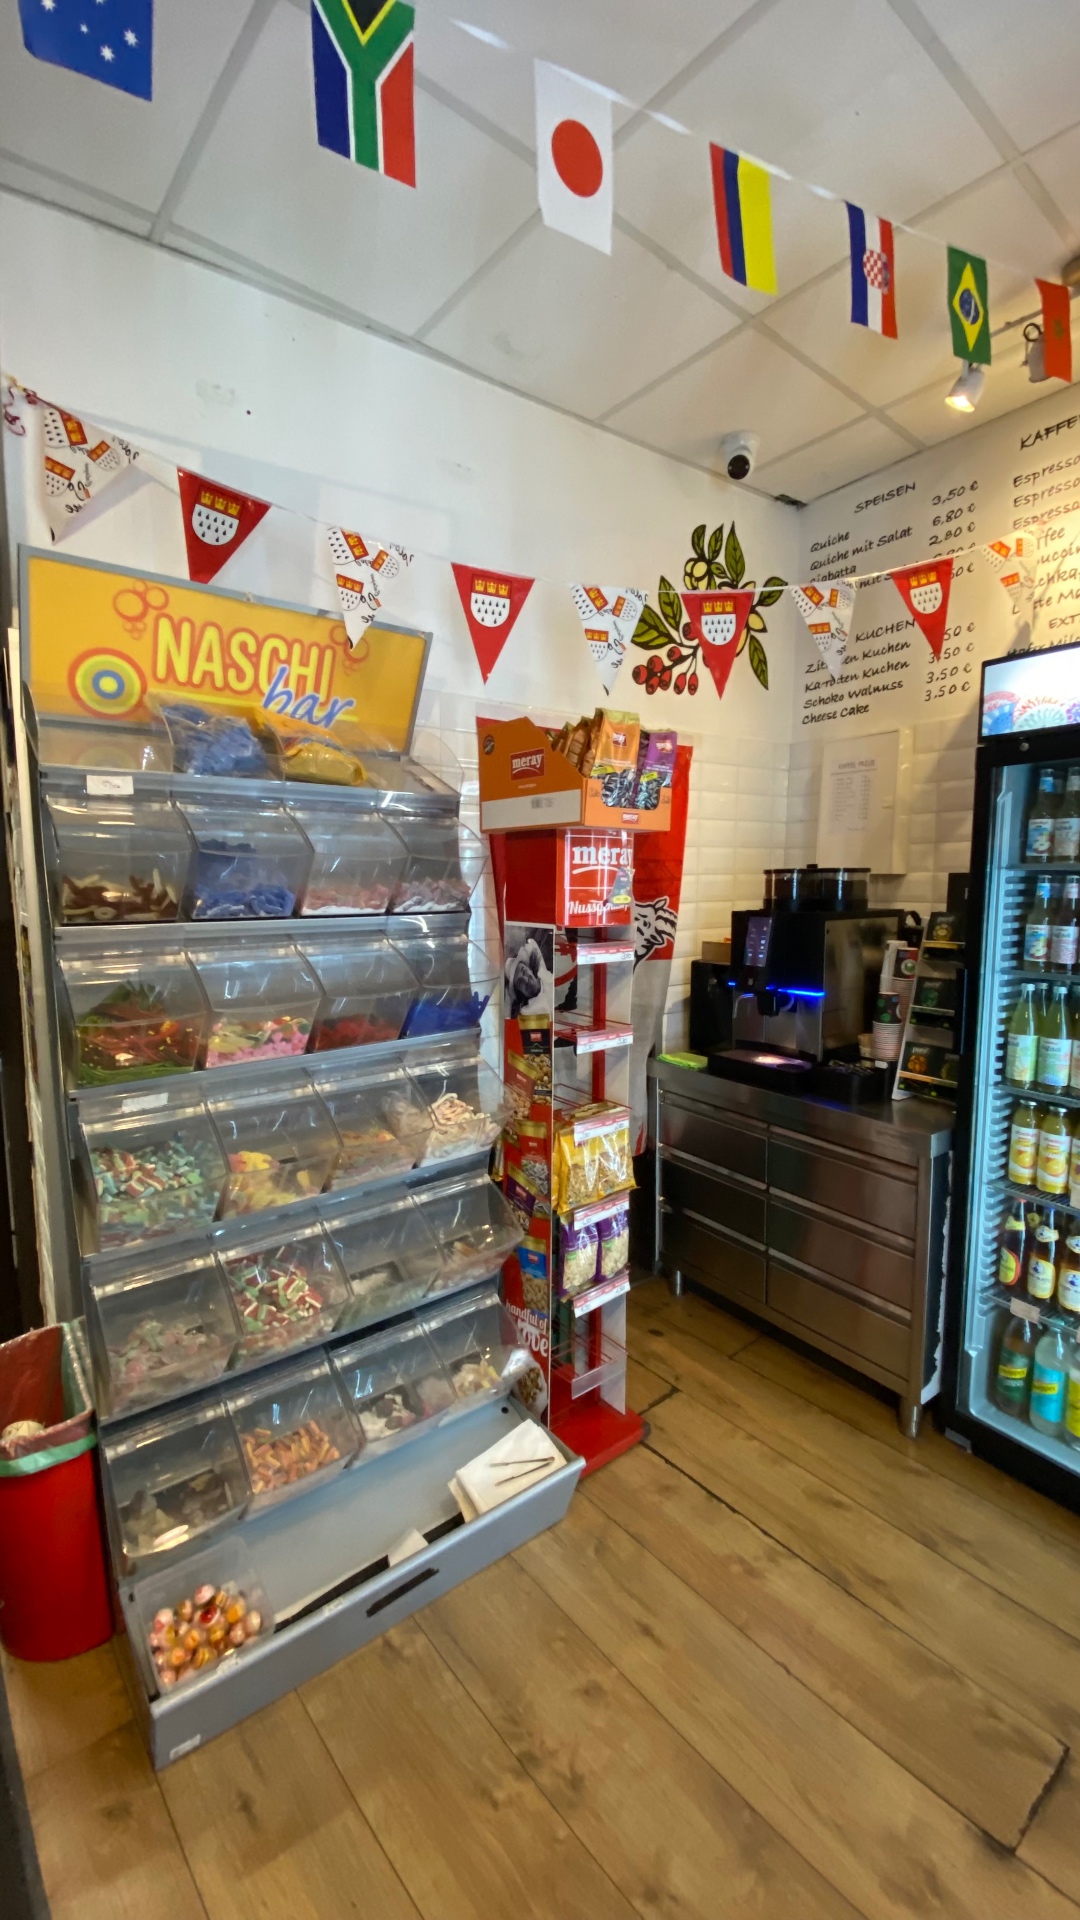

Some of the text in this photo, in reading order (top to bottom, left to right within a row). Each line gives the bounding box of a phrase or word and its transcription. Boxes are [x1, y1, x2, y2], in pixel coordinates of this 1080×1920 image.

[1019, 414, 1080, 451] KAFFE
[1013, 454, 1080, 488] Espresso
[854, 481, 916, 513] SPEISEN
[1013, 477, 1080, 508] Espresso
[810, 480, 979, 553] Quiche 3,50 €
[967, 521, 976, 533] €
[809, 550, 849, 571] Quiche
[852, 539, 874, 556] mit
[876, 526, 912, 547] Salat
[967, 503, 976, 513] €
[966, 562, 975, 573] €
[855, 618, 916, 643] KUCHEN
[862, 641, 911, 660] Kuchen
[966, 621, 976, 633] €
[154, 613, 335, 704] NASCHI
[862, 661, 910, 679] Kuchen
[966, 642, 975, 652] €
[262, 665, 355, 729] bar
[802, 709, 838, 725] Cheese
[839, 704, 870, 718] Cake
[961, 681, 971, 692] €
[803, 693, 844, 709] Schoko
[963, 662, 972, 673] €
[511, 752, 544, 769] meray
[572, 845, 633, 868] meray
[505, 1297, 549, 1335] handful of
